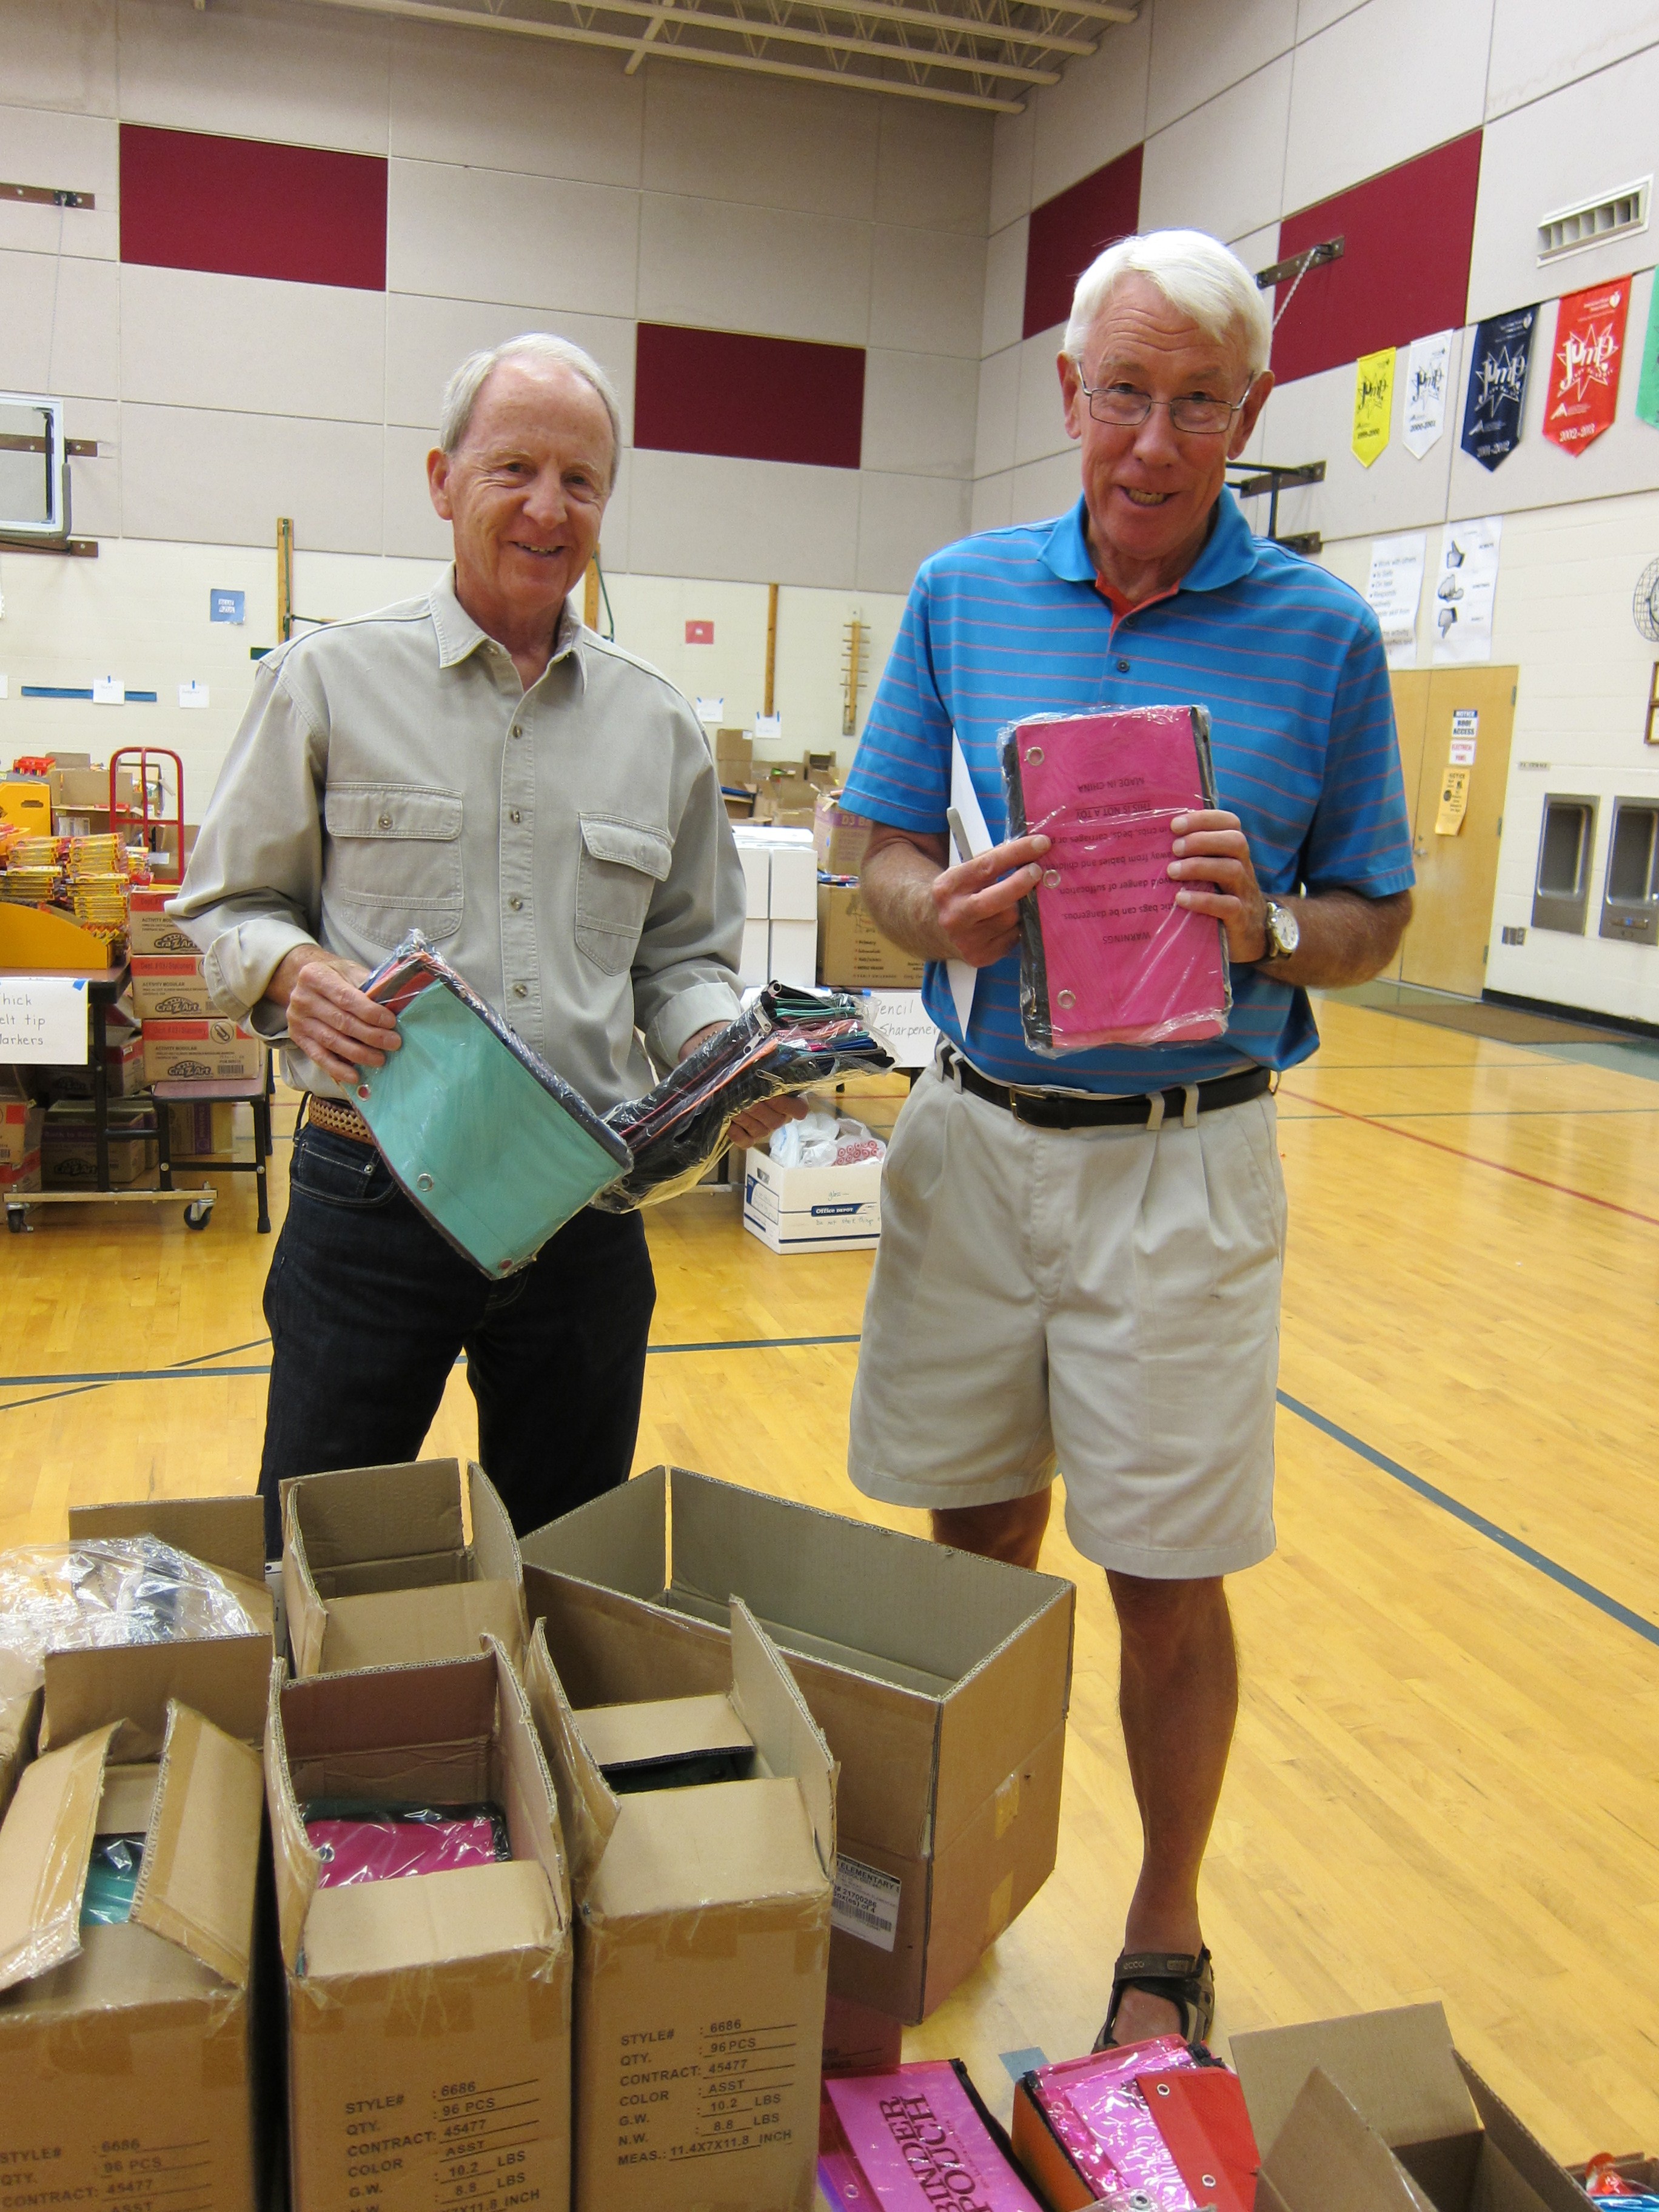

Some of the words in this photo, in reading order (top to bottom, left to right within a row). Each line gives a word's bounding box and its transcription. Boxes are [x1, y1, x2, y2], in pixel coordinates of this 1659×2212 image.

[1077, 782, 1105, 793] CHINA
[1107, 780, 1116, 788] IN
[1119, 777, 1144, 788] MADE
[1076, 810, 1092, 820] TOY
[1103, 807, 1121, 816] NOT
[1123, 805, 1130, 813] IS
[1132, 802, 1151, 812] THIS
[1070, 833, 1107, 844] carriages
[1081, 859, 1096, 868] and
[1099, 856, 1125, 866] babies
[1128, 854, 1148, 863] from
[1058, 884, 1105, 894] suffocation.
[1108, 882, 1117, 892] of
[1119, 879, 1148, 888] danger
[1062, 910, 1107, 920] dangerous.
[1109, 909, 1119, 917] be
[1139, 903, 1158, 913] bags
[1102, 931, 1150, 944] WARNINGS
[0, 993, 32, 1006] hick
[0, 1014, 15, 1025] elt
[25, 1014, 45, 1031] tip
[840, 1861, 894, 1890] ELEMENTARY
[621, 2029, 674, 2045] STYLE#
[710, 2019, 741, 2033] 6686
[620, 2053, 652, 2066] QTY.
[711, 2042, 726, 2053] 96
[729, 2038, 756, 2051] PCS
[620, 2065, 701, 2086] CONTRACT:
[709, 2059, 748, 2074] 45477
[346, 2094, 404, 2114] STYLE#
[441, 2081, 475, 2097] 6686
[620, 2091, 669, 2106] COLOR
[709, 2079, 745, 2092] ASST
[347, 2120, 380, 2136] QTY.
[443, 2103, 459, 2116] 96
[465, 2097, 495, 2112] PCS
[619, 2114, 649, 2126] G.W.
[711, 2098, 737, 2111] 10.2
[755, 2094, 781, 2106] LBS
[347, 2131, 437, 2157] CONTRACT:
[444, 2119, 486, 2137] 45477
[618, 2133, 649, 2147] N.W.
[714, 2120, 734, 2131] 8.8
[754, 2113, 780, 2126] LBS
[671, 2135, 749, 2156] 11.4X7X11.8
[760, 2130, 792, 2143] INCH
[0, 2148, 61, 2163] STYLE#
[348, 2158, 403, 2177] COLOR
[446, 2140, 484, 2156] ASST
[880, 2095, 963, 2212] BINDER
[903, 2093, 994, 2212] POUCH
[105, 2160, 122, 2173] 96
[130, 2156, 161, 2170] PCS
[349, 2184, 383, 2198] G.W.
[449, 2162, 478, 2177] 10.2
[498, 2150, 525, 2167] LBS
[456, 2182, 477, 2196] 8.8
[497, 2172, 525, 2188] LBS
[2, 2186, 98, 2208] CONTRACT:
[108, 2179, 153, 2194] 45477
[505, 2188, 540, 2207] INCH
